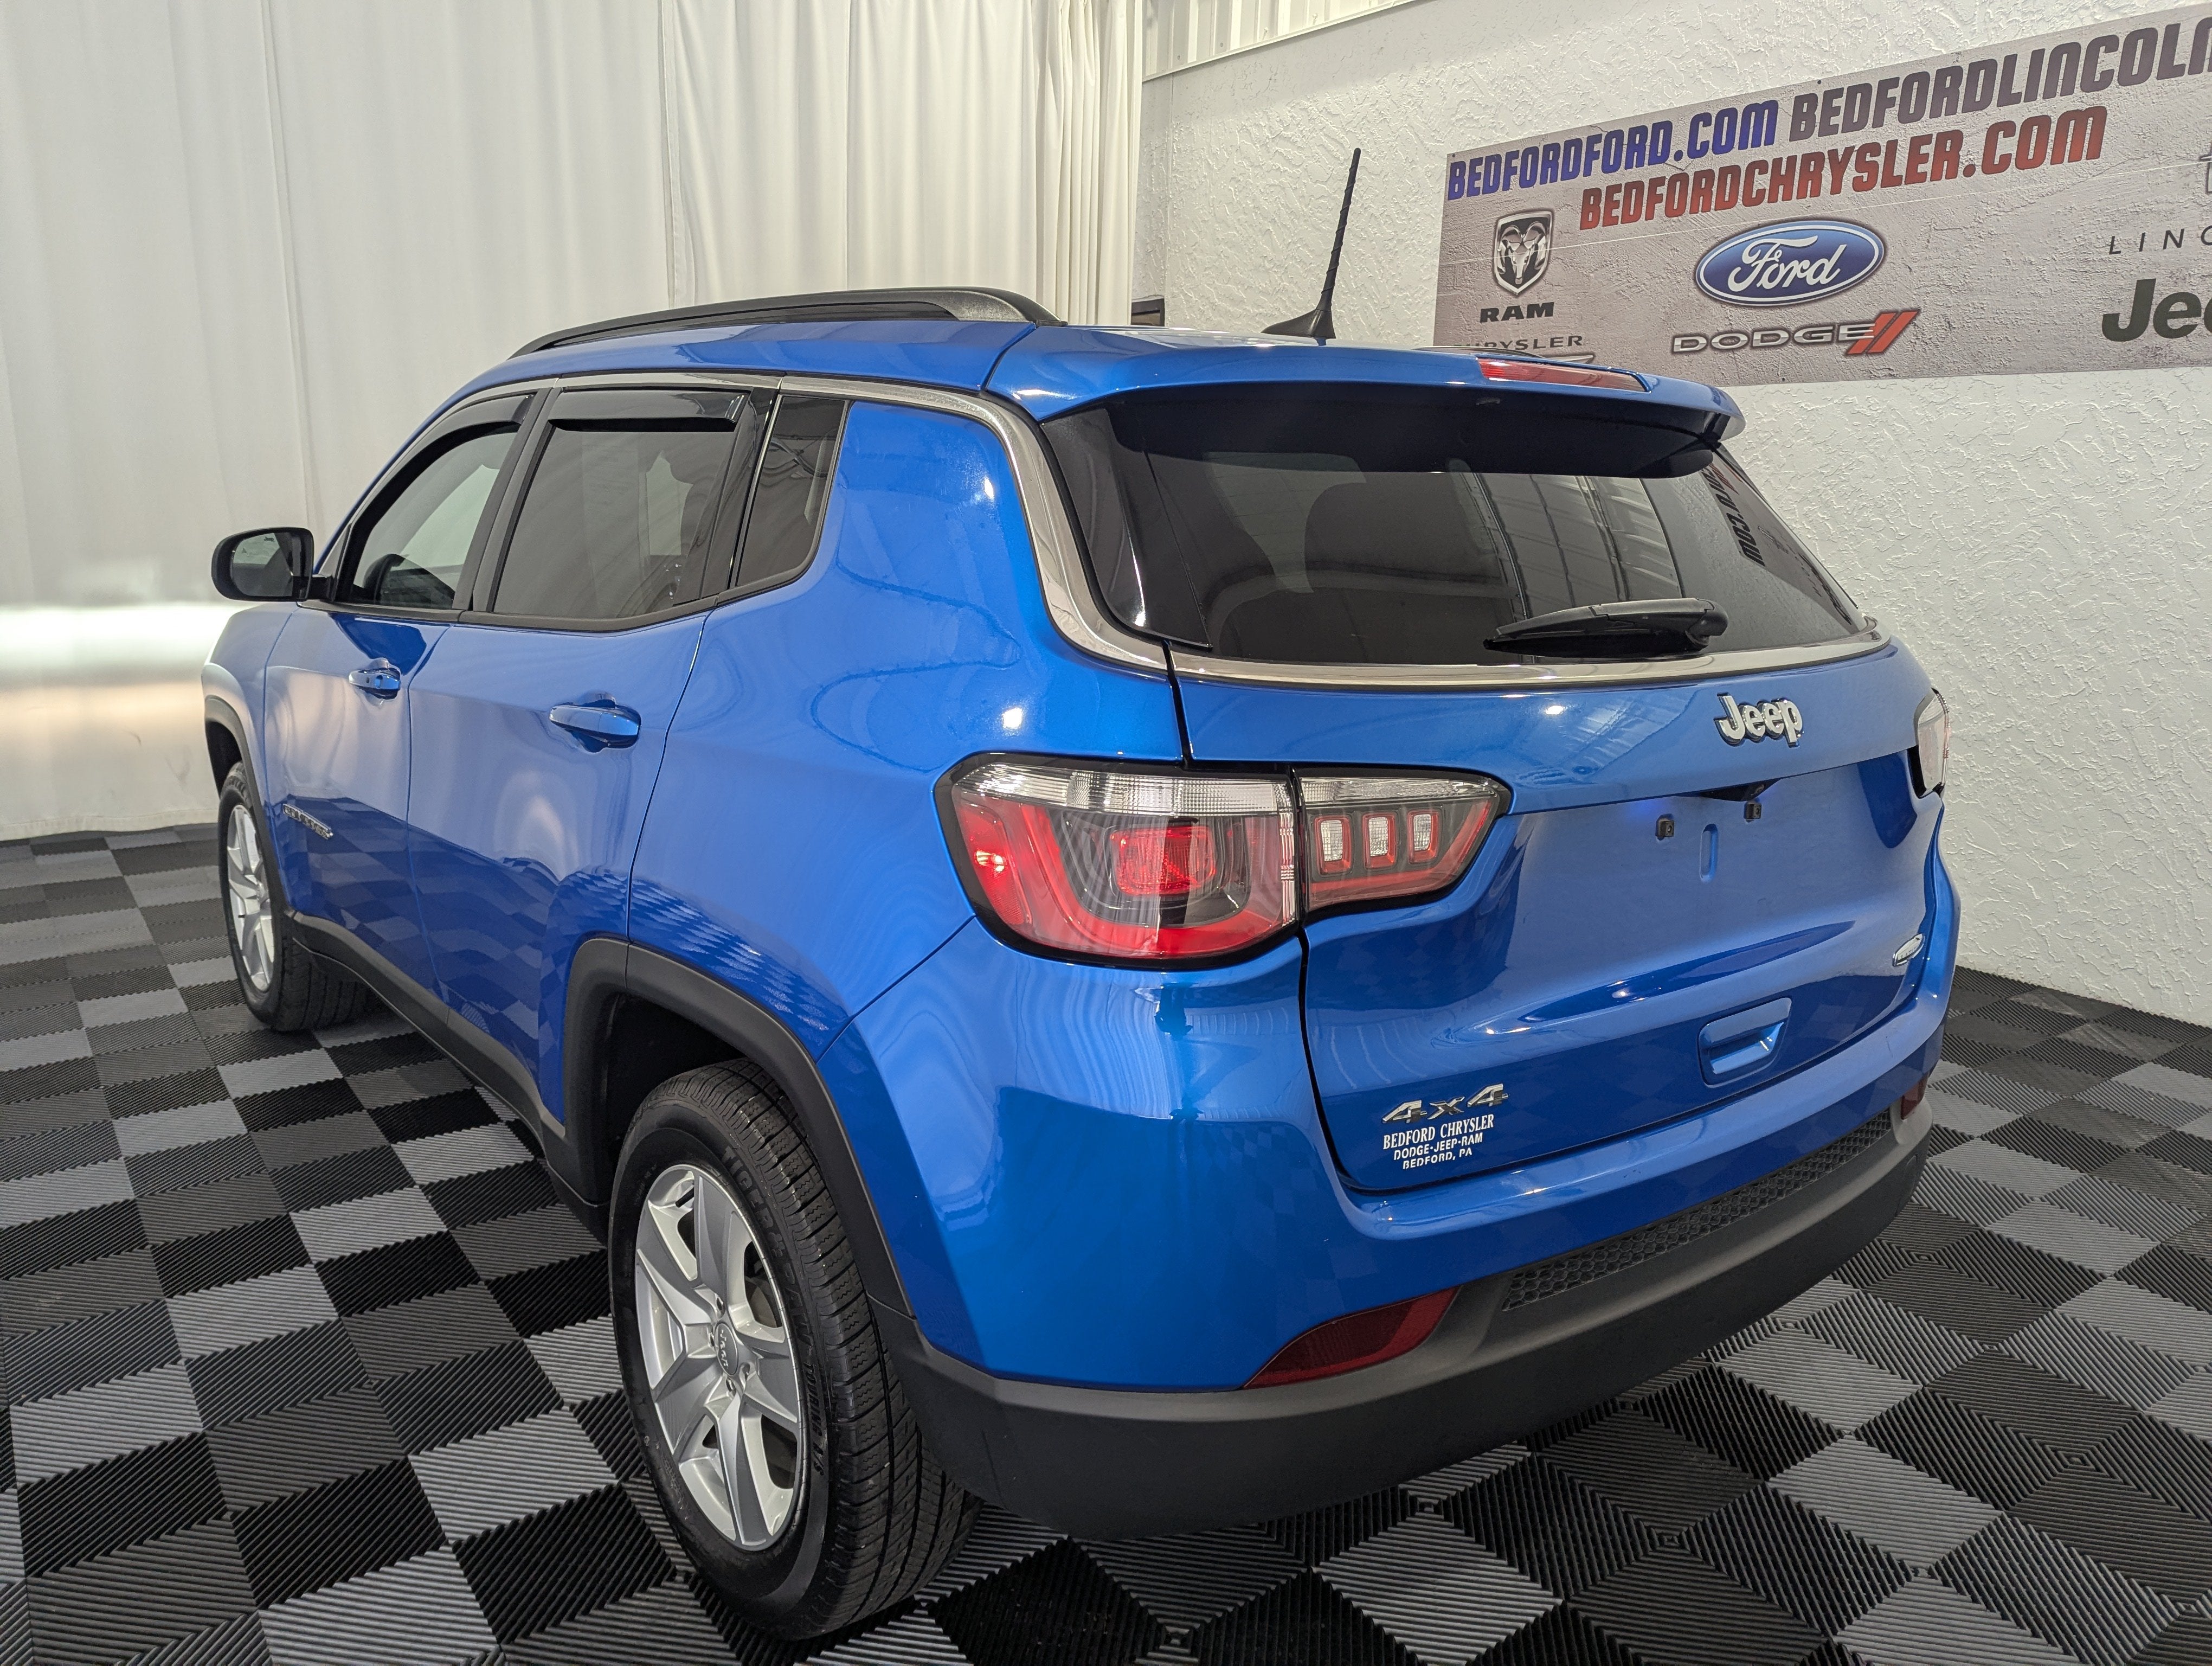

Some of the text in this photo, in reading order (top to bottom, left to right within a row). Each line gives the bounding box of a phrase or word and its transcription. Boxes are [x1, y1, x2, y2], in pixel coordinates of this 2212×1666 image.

[1447, 99, 1779, 201] BEDFORDFORD.COM
[1579, 106, 2107, 230] BEDFORDCHRYSLER.COM
[1727, 235, 1847, 292] Ford
[1480, 302, 1554, 323] RAM
[1671, 322, 1875, 354] DODGE
[2101, 278, 2212, 342] Je
[1714, 692, 1803, 748] Jeep
[1382, 1113, 1494, 1150] BEDFORD CHRYSLER
[1402, 1147, 1472, 1170] BEDFORD, PA
